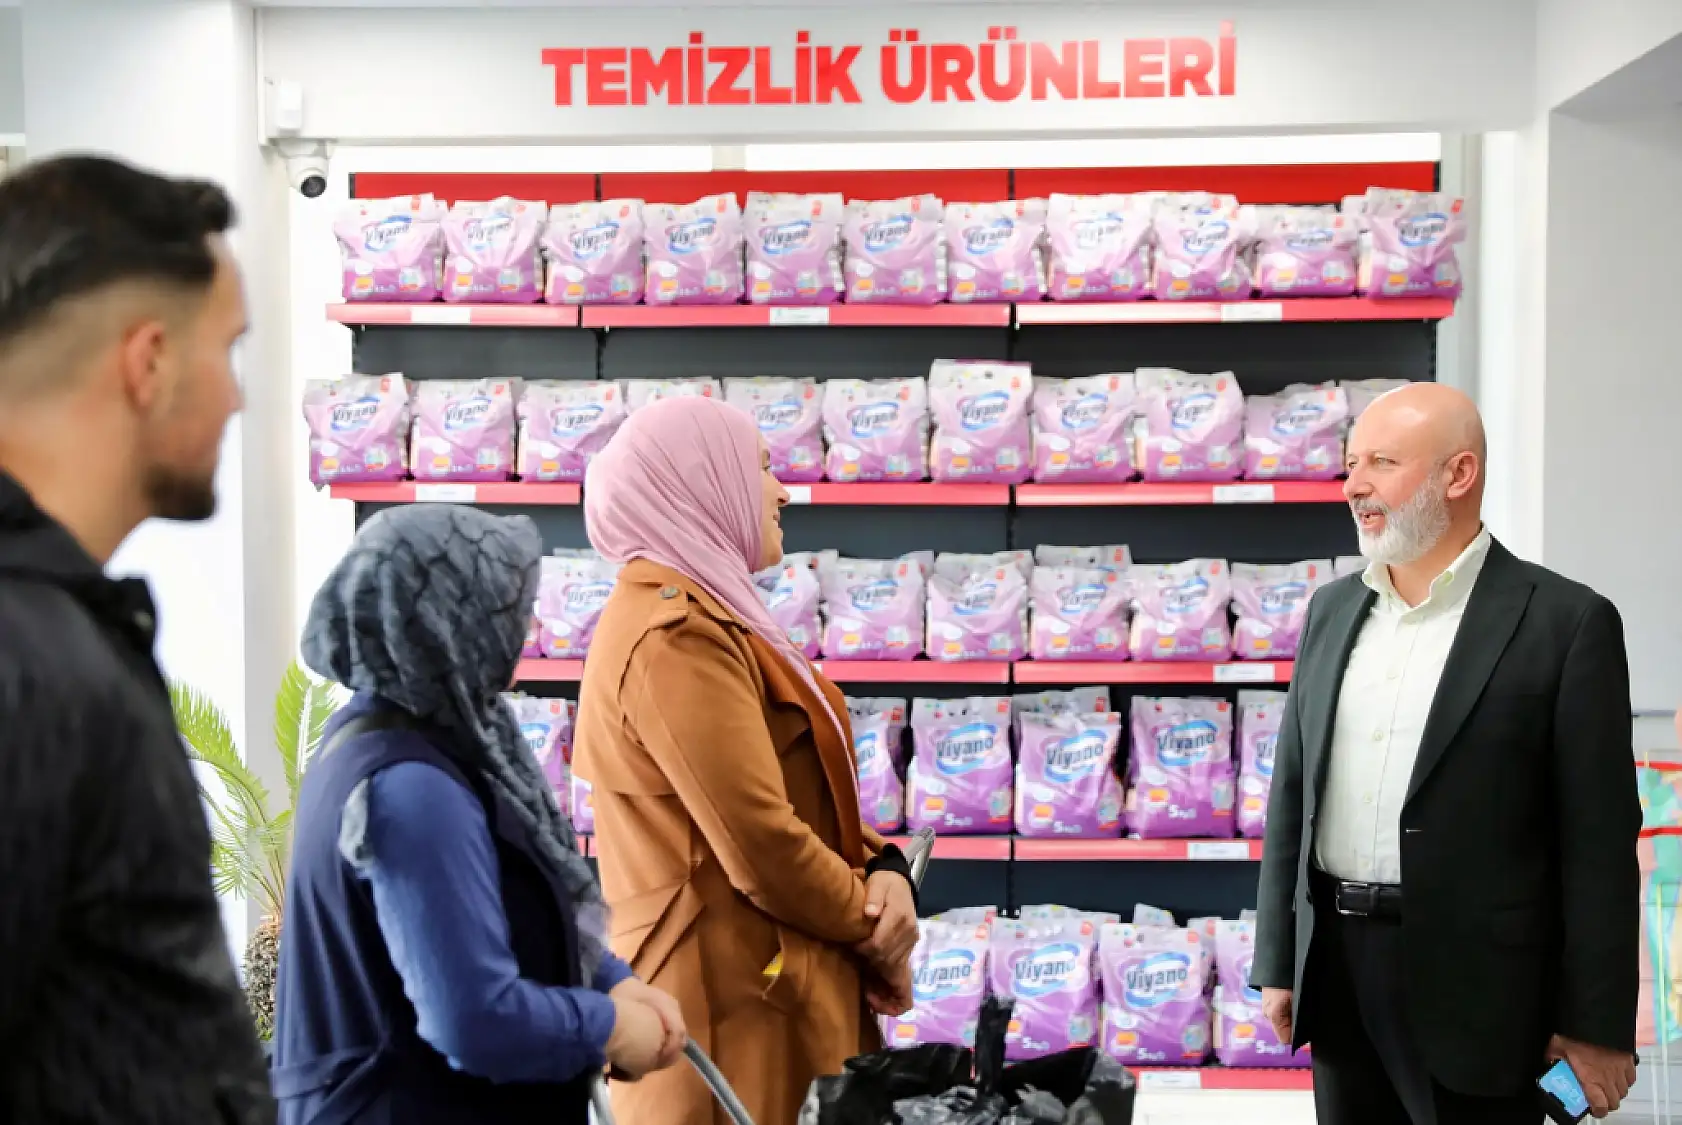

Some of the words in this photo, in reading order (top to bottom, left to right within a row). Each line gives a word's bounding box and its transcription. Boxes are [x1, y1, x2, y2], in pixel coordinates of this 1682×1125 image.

[541, 31, 862, 105] TEMİZLİK
[880, 20, 1237, 103] ÜRÜNLERİ
[936, 737, 993, 760] Viyano
[1158, 731, 1216, 754] Viyano
[1046, 743, 1104, 769] Viyano
[913, 964, 971, 985] Viyano
[1015, 960, 1075, 982] Viyano
[1127, 966, 1187, 992] Viyano
